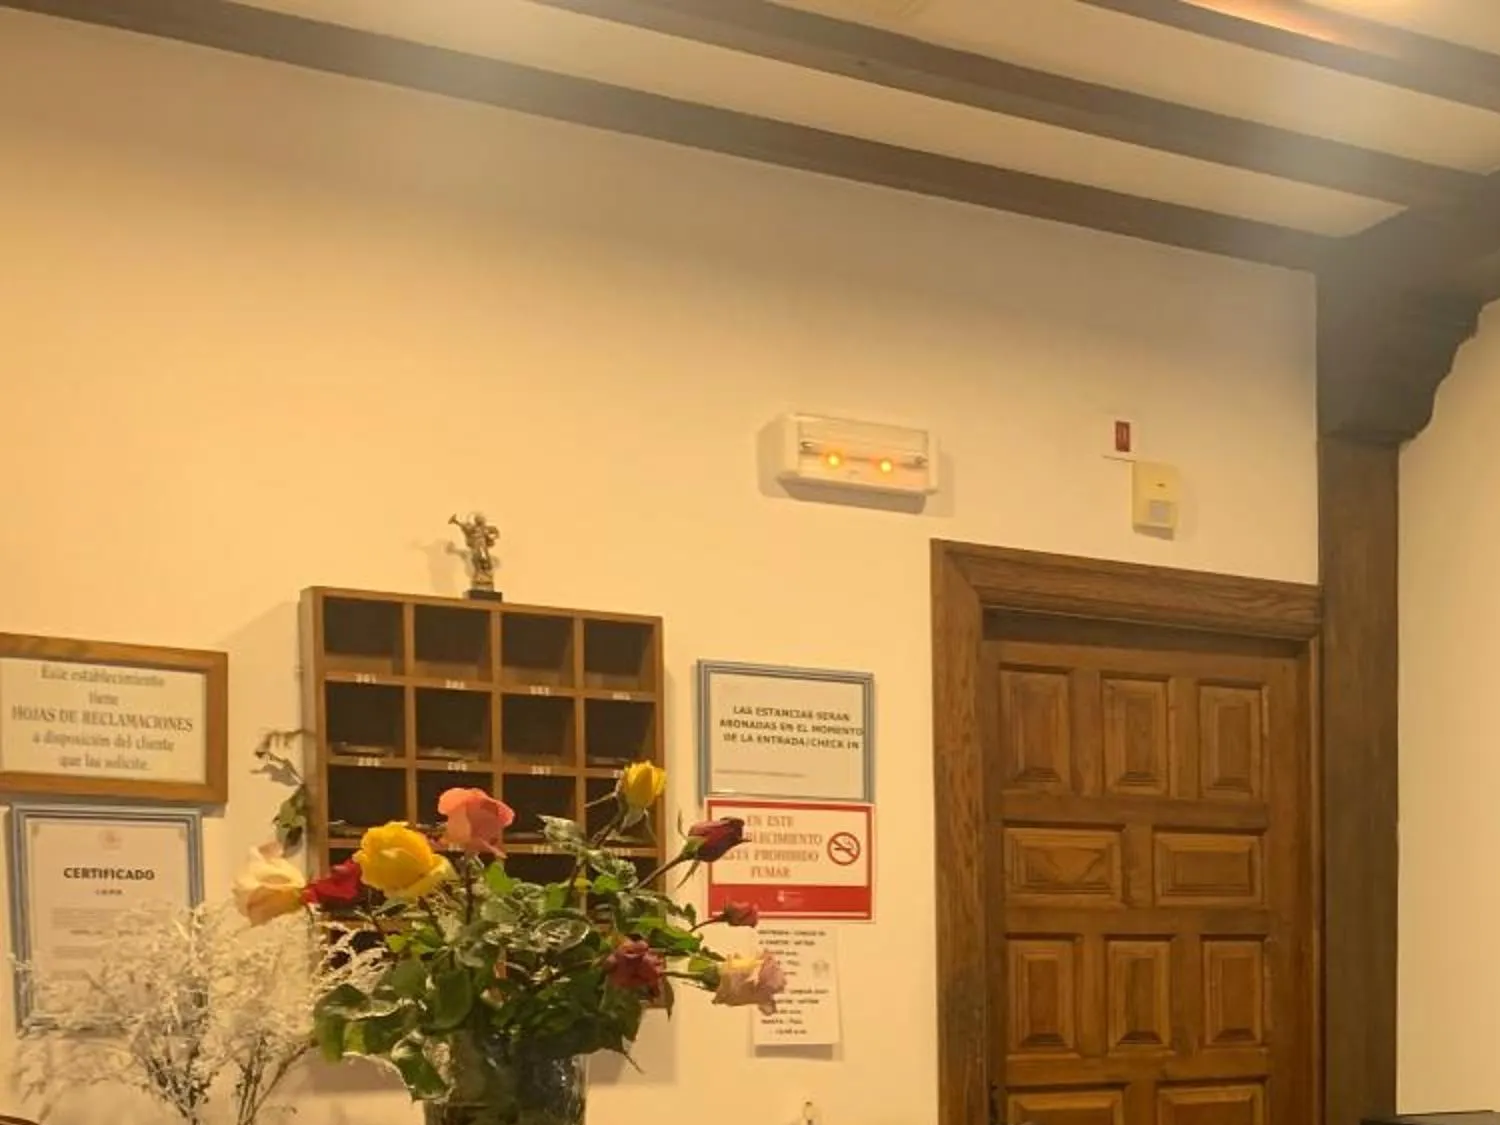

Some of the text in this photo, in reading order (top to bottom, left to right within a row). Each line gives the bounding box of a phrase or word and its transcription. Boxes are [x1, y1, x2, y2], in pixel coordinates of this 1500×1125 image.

[71, 669, 165, 687] establecimiento
[88, 690, 119, 705] tiene
[733, 704, 752, 715] LAS
[11, 704, 193, 732] HOJAS DE RECLAMACIONES
[719, 718, 777, 731] ABONADAS
[779, 722, 794, 733] EN
[796, 723, 808, 733] EL
[114, 733, 132, 749] del
[135, 735, 175, 752] cliente
[740, 733, 753, 743] LA
[58, 754, 81, 768] que
[85, 752, 101, 768] las
[63, 867, 155, 881] CERTIFICADO
